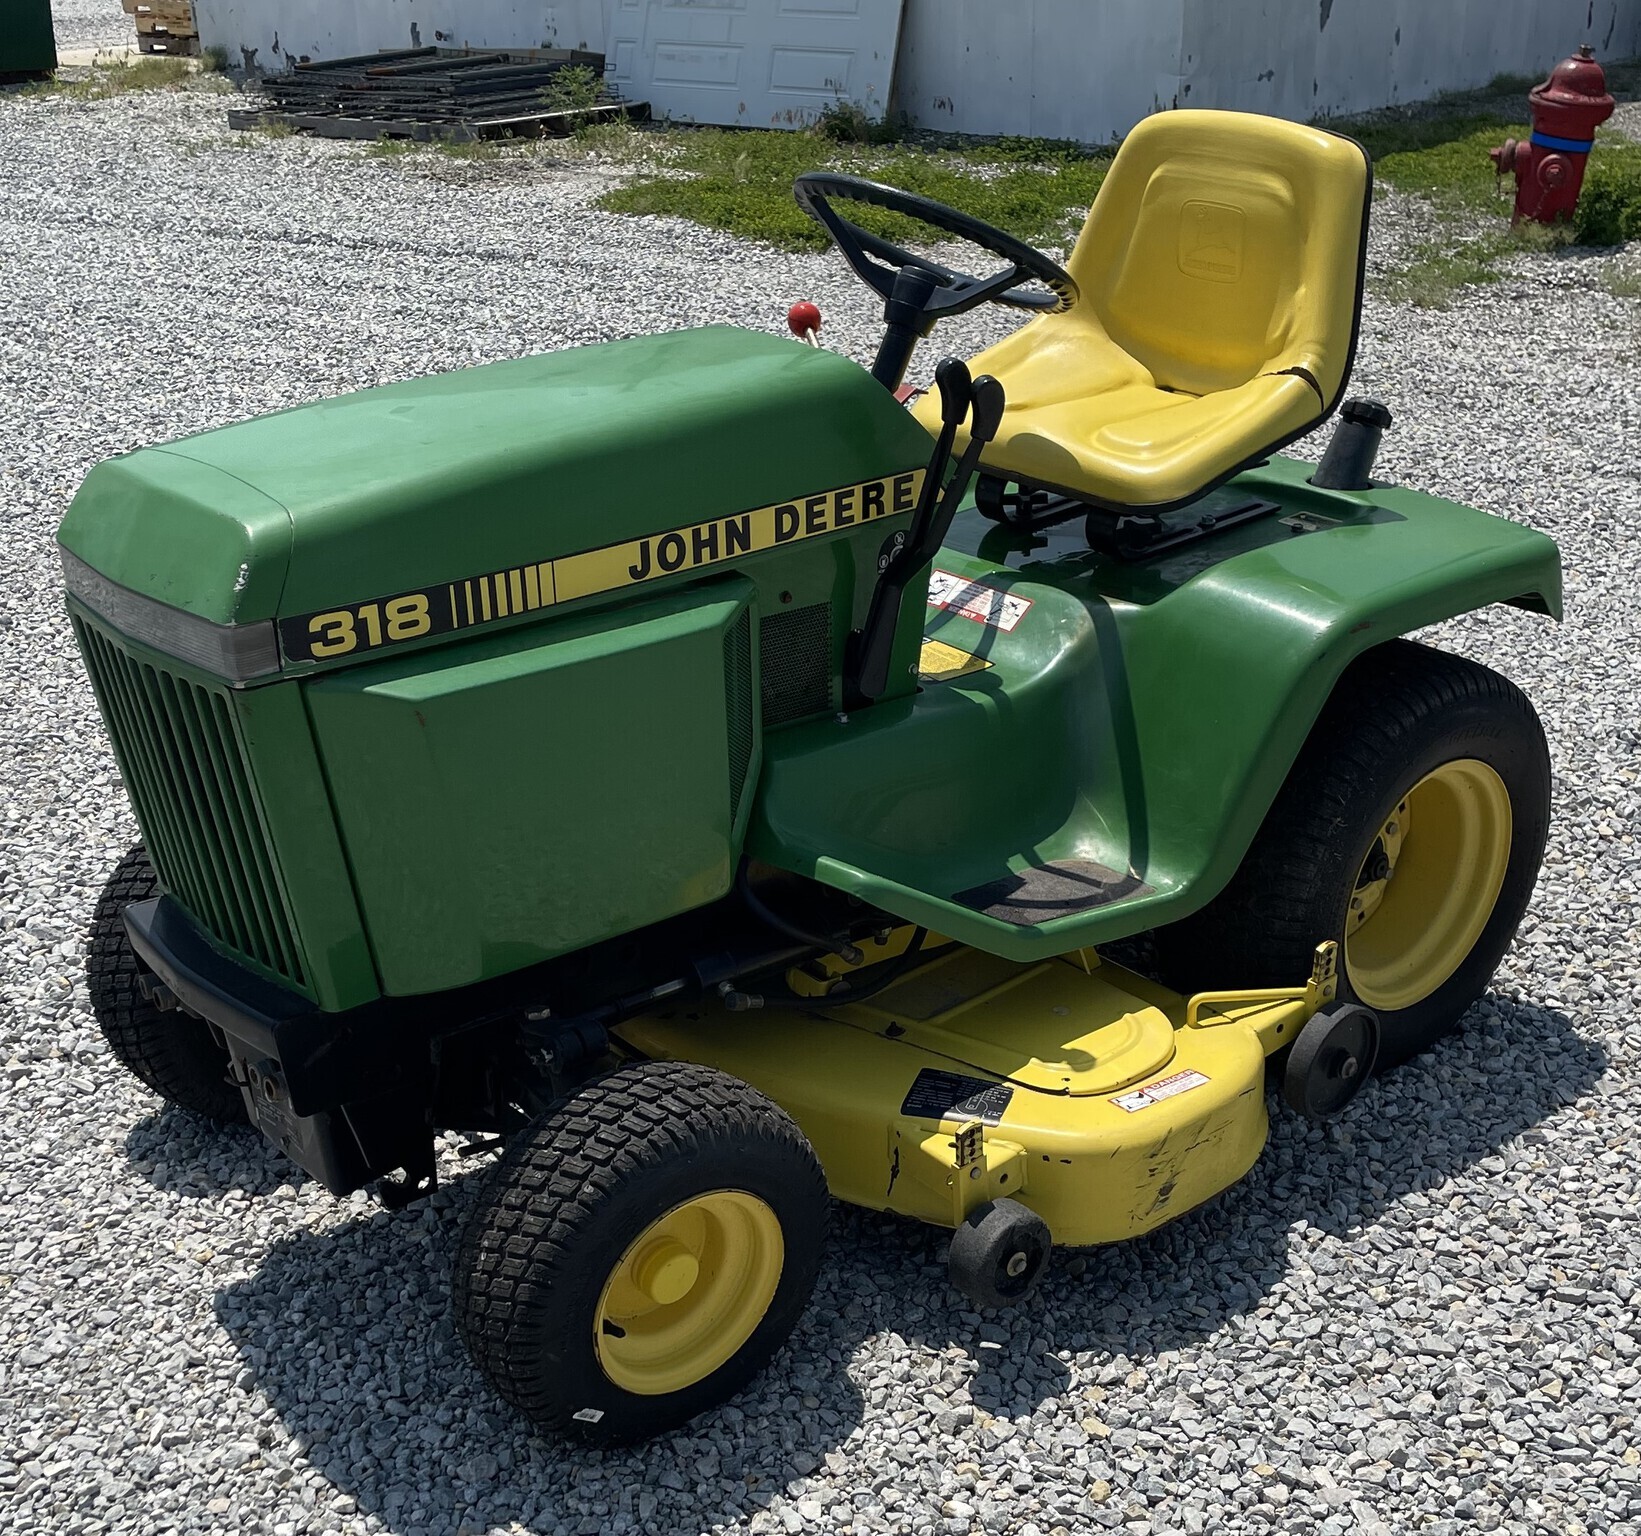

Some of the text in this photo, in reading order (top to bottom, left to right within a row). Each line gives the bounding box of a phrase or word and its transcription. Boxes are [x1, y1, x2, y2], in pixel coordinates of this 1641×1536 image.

[629, 474, 914, 580] JOHN DEERE
[309, 594, 432, 657] 318
